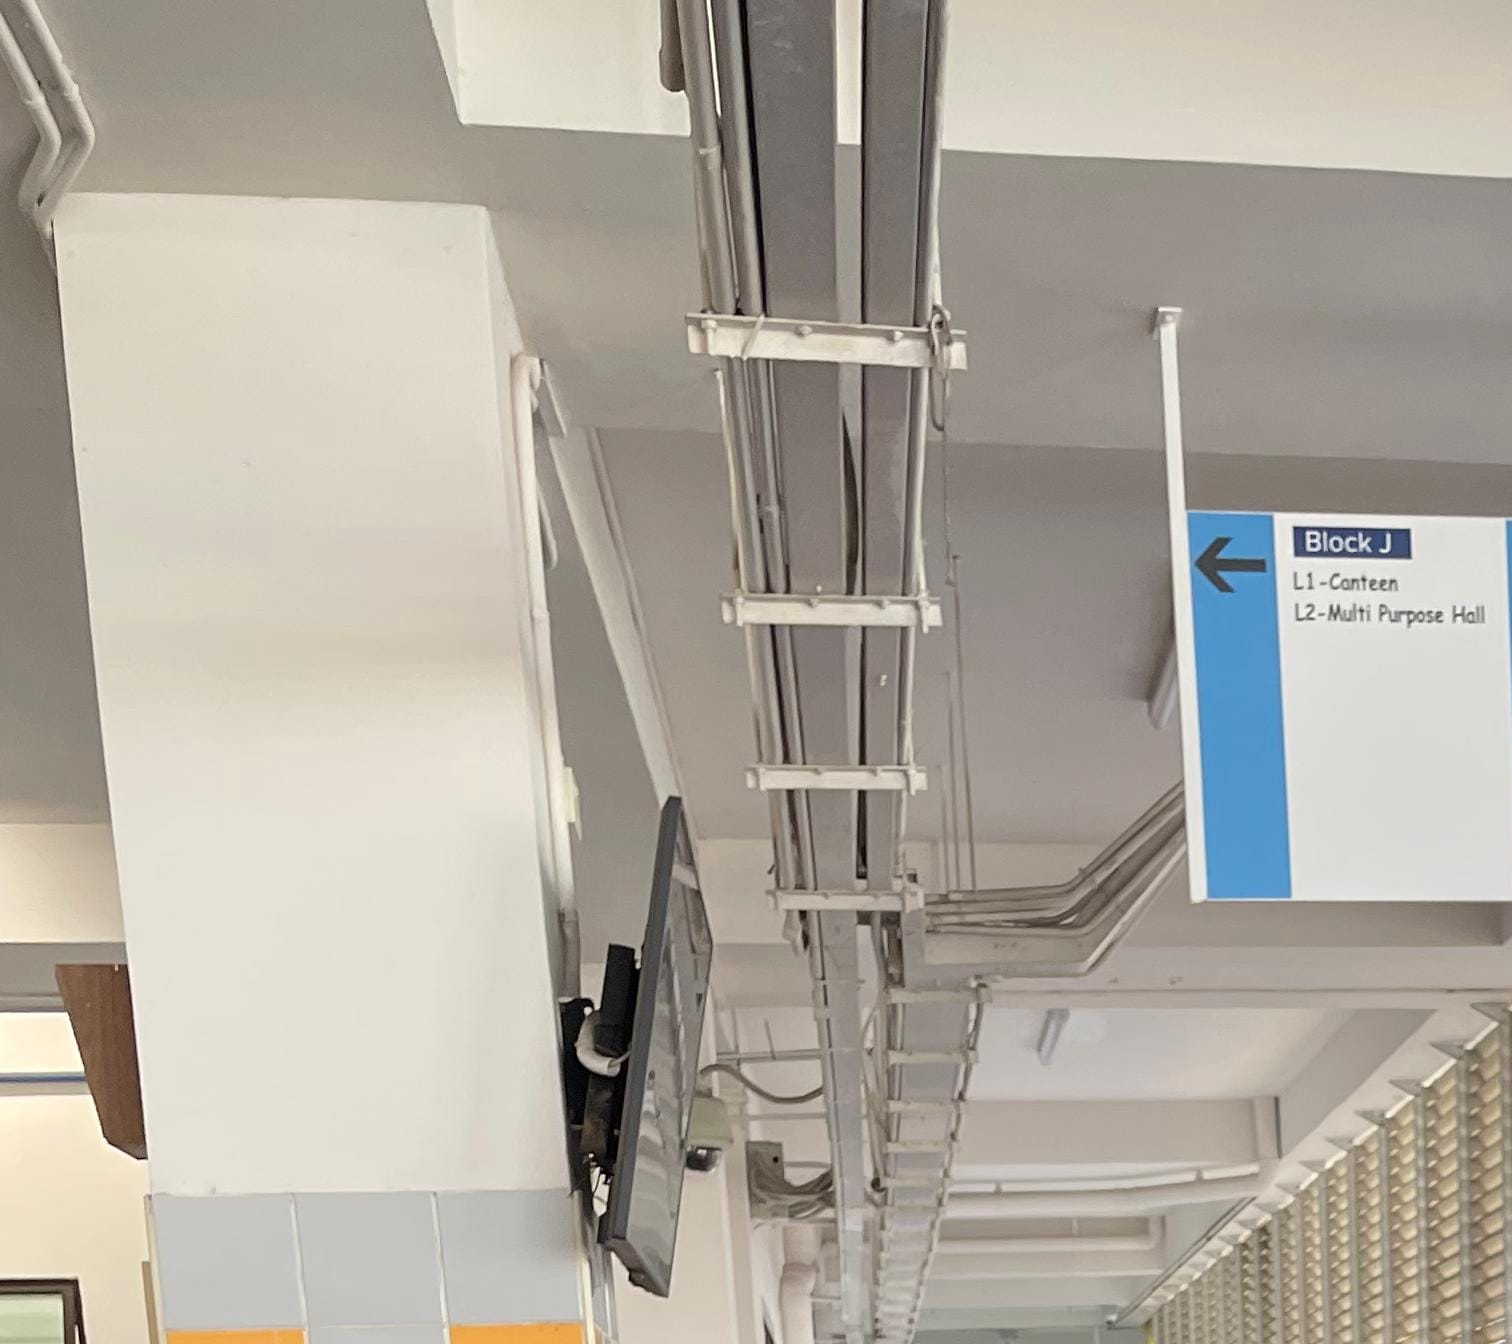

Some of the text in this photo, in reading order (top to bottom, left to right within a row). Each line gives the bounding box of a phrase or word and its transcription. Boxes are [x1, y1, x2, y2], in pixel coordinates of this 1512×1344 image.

[1306, 531, 1391, 553] Block J
[1294, 572, 1398, 591] L1-Canteen
[1295, 604, 1485, 628] L2-Multi Purpose Hall
